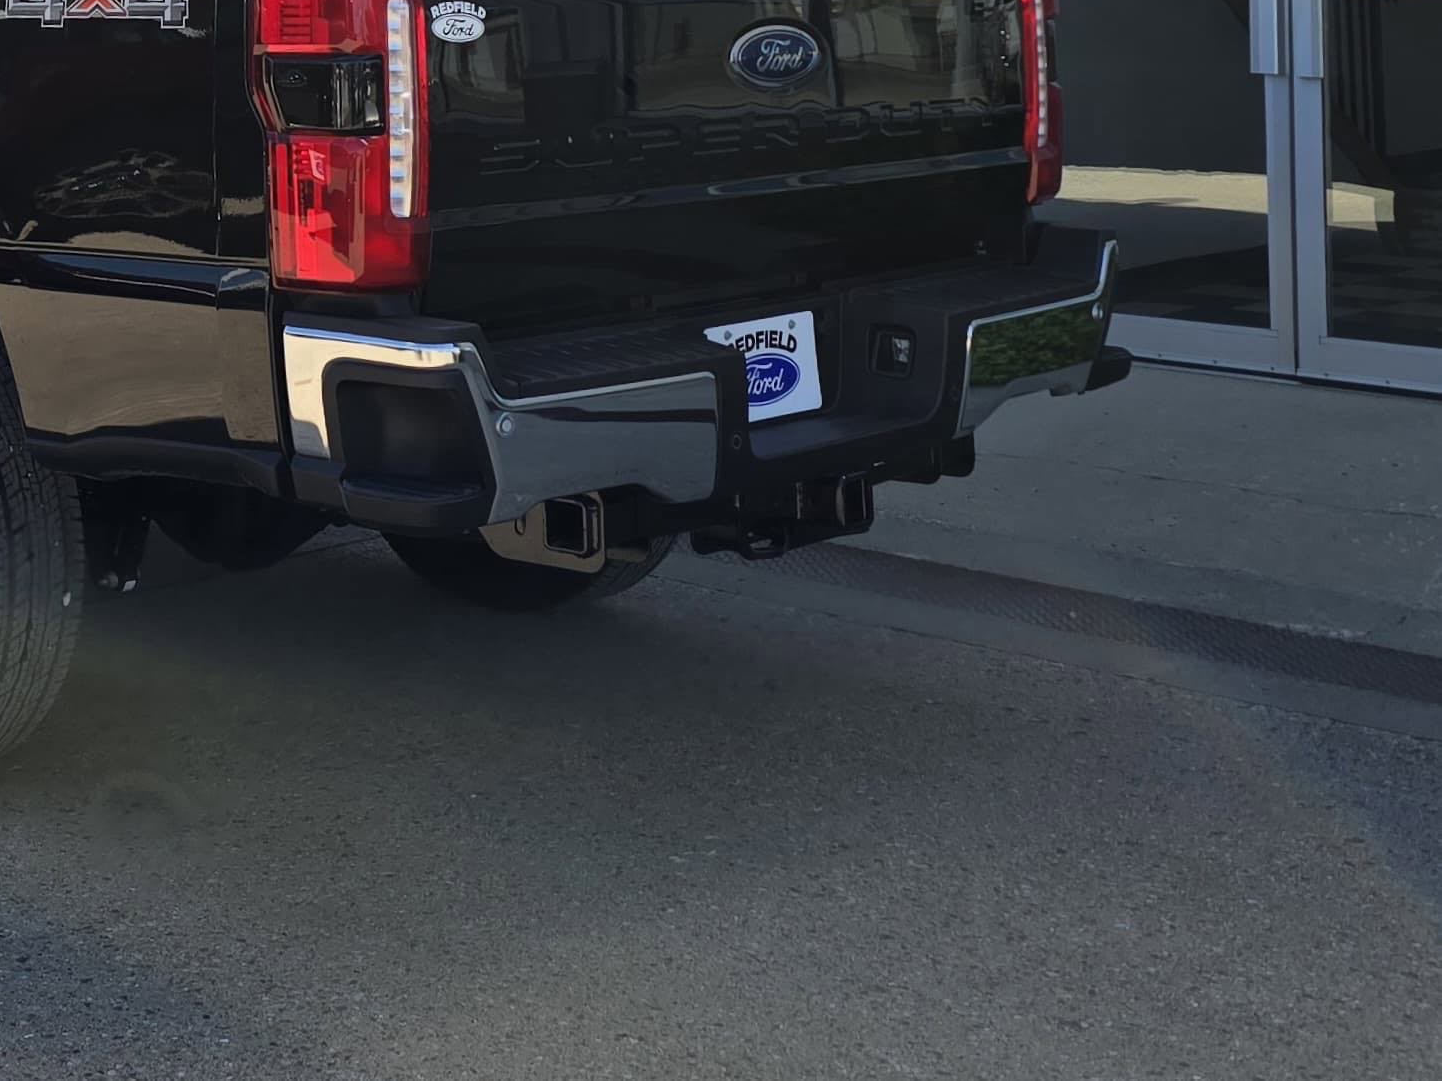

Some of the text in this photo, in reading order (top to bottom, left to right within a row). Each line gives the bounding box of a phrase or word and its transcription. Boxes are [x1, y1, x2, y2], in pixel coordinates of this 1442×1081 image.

[430, 1, 487, 19] REDFIELD
[443, 18, 474, 36] Ford
[756, 39, 804, 72] Ford
[730, 330, 798, 354] EDFIELD
[746, 362, 784, 395] Ford
